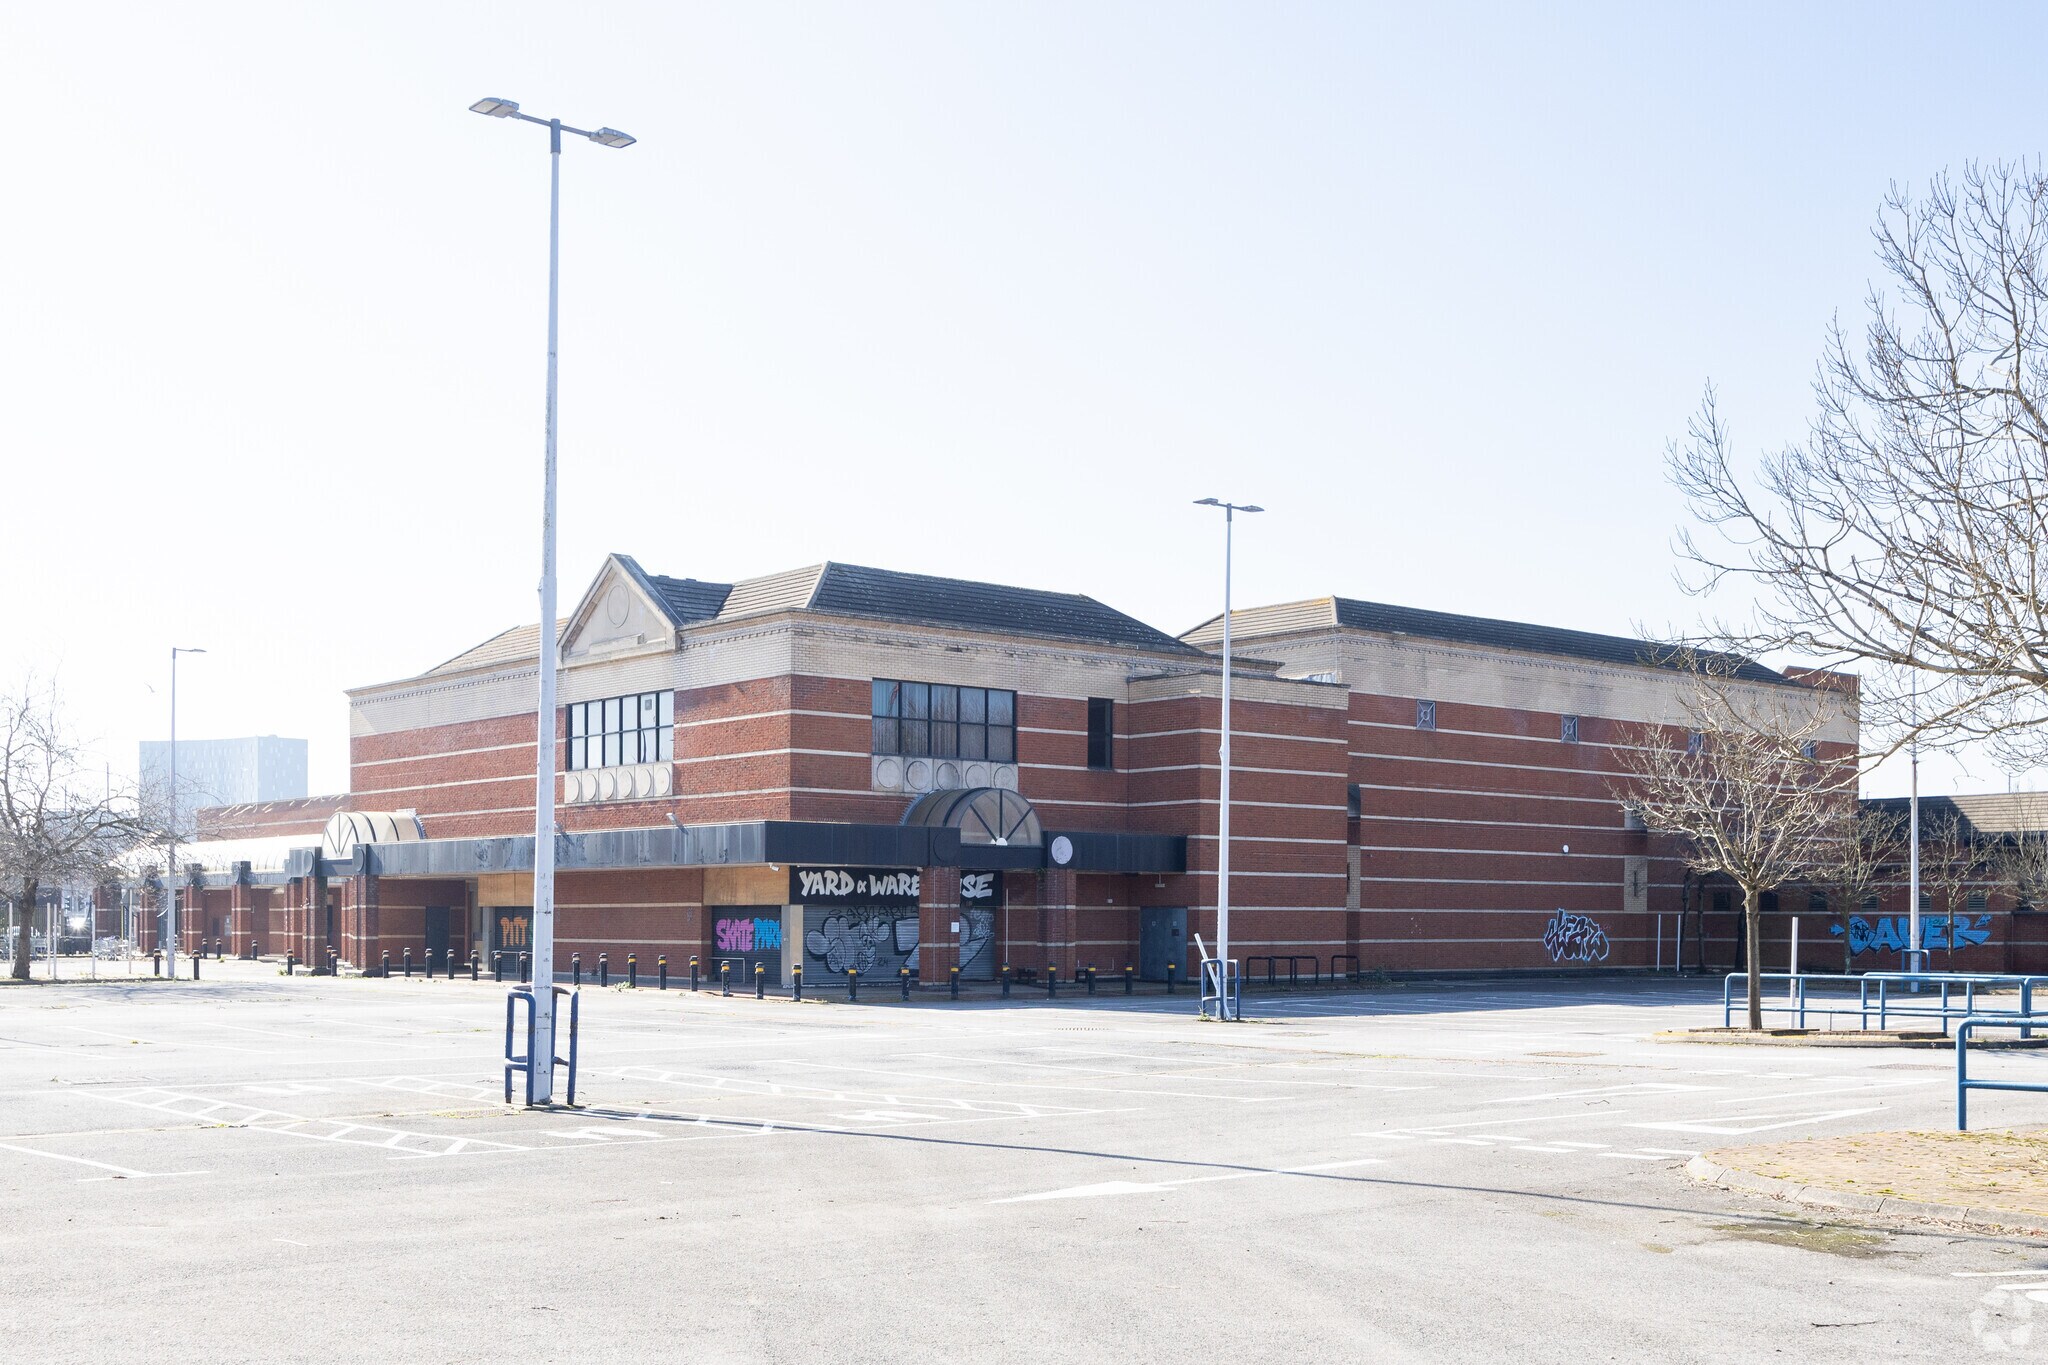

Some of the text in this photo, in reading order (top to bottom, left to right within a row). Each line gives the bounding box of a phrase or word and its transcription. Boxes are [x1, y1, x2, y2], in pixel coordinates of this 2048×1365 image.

[799, 870, 855, 896] YARD
[869, 872, 994, 898] WARESE
[716, 918, 754, 952] SKATE
